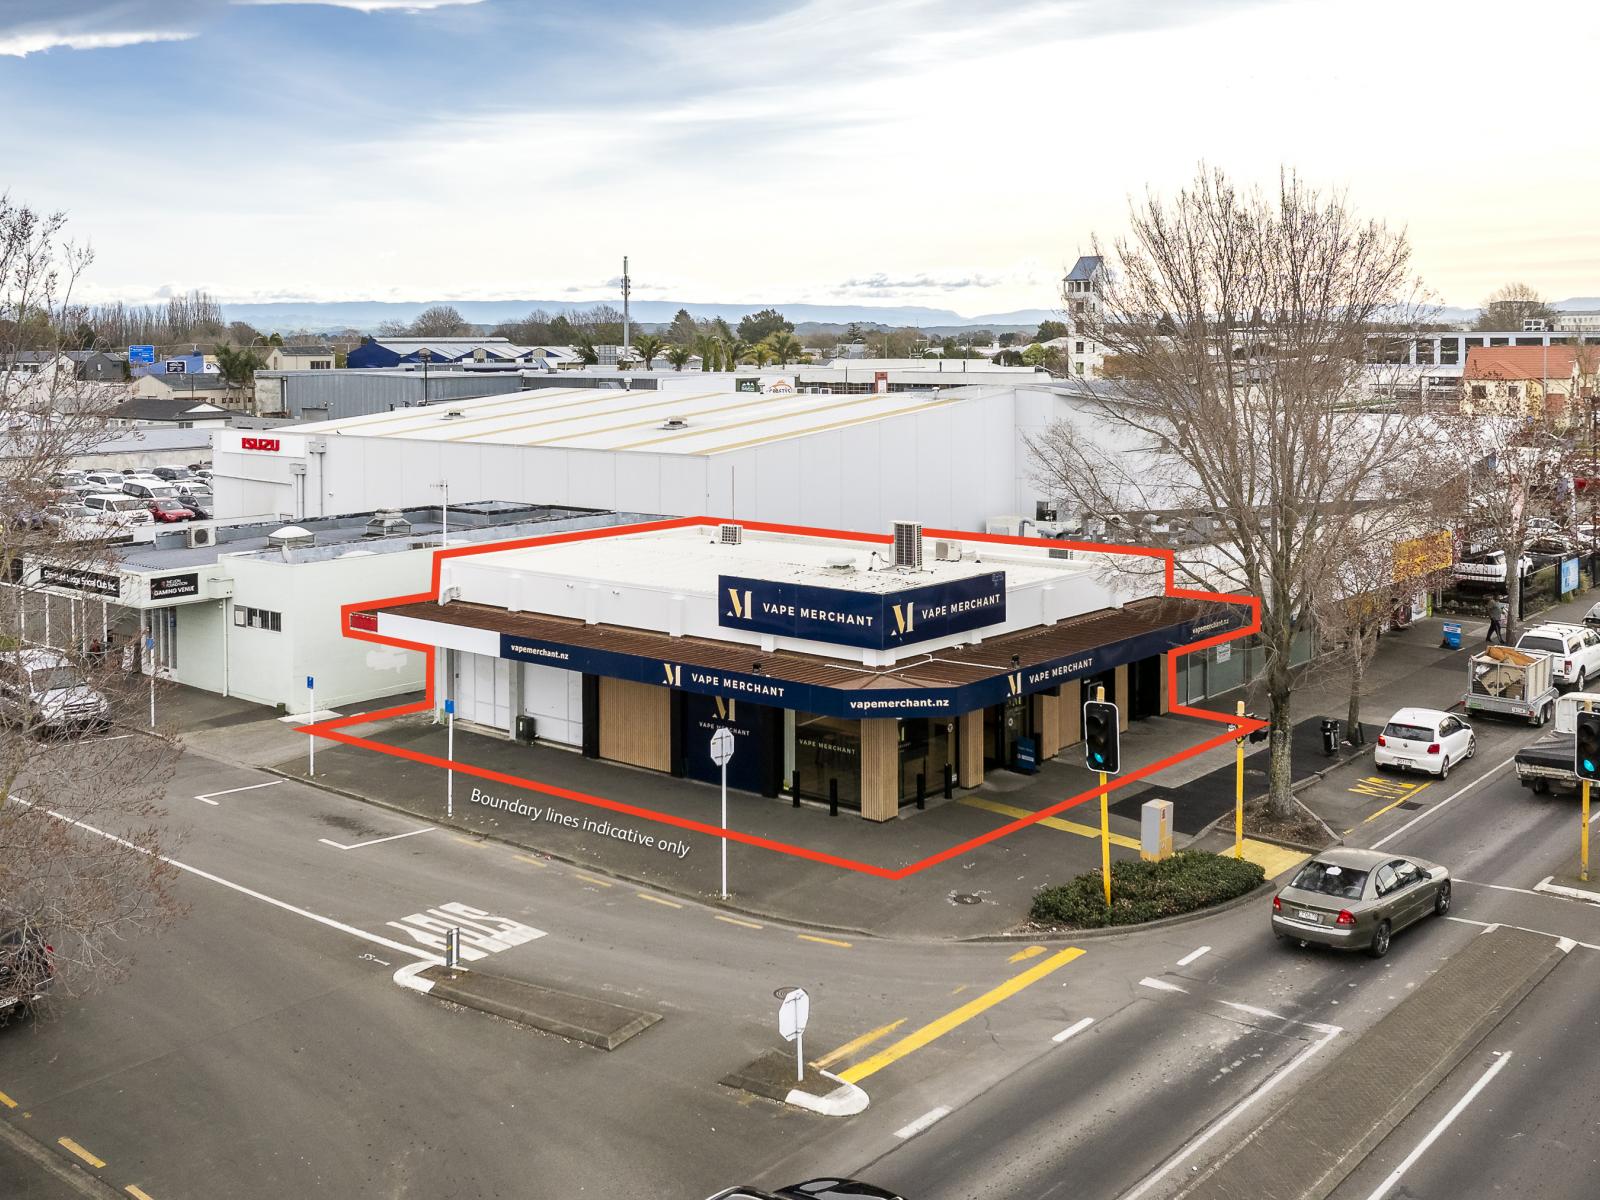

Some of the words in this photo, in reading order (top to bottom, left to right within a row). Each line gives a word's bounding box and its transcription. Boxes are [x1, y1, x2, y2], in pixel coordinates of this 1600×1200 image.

[242, 438, 280, 451] ISUZU
[154, 588, 177, 596] GAMING
[763, 602, 795, 616] VAPE
[800, 608, 873, 627] MERCHANT
[922, 605, 947, 619] VAPE
[951, 593, 1000, 613] MERCHANT
[510, 643, 569, 660] vapemerchant.nz
[1029, 671, 1049, 684] VAPE
[1052, 658, 1093, 678] MERCHANT
[691, 672, 719, 686] VAPE
[723, 678, 785, 697] MERCHANT
[850, 698, 950, 710] vapemerchant.nz
[699, 721, 714, 729] VAPE
[799, 738, 816, 747] VAPE
[819, 742, 855, 755] MERCHANT
